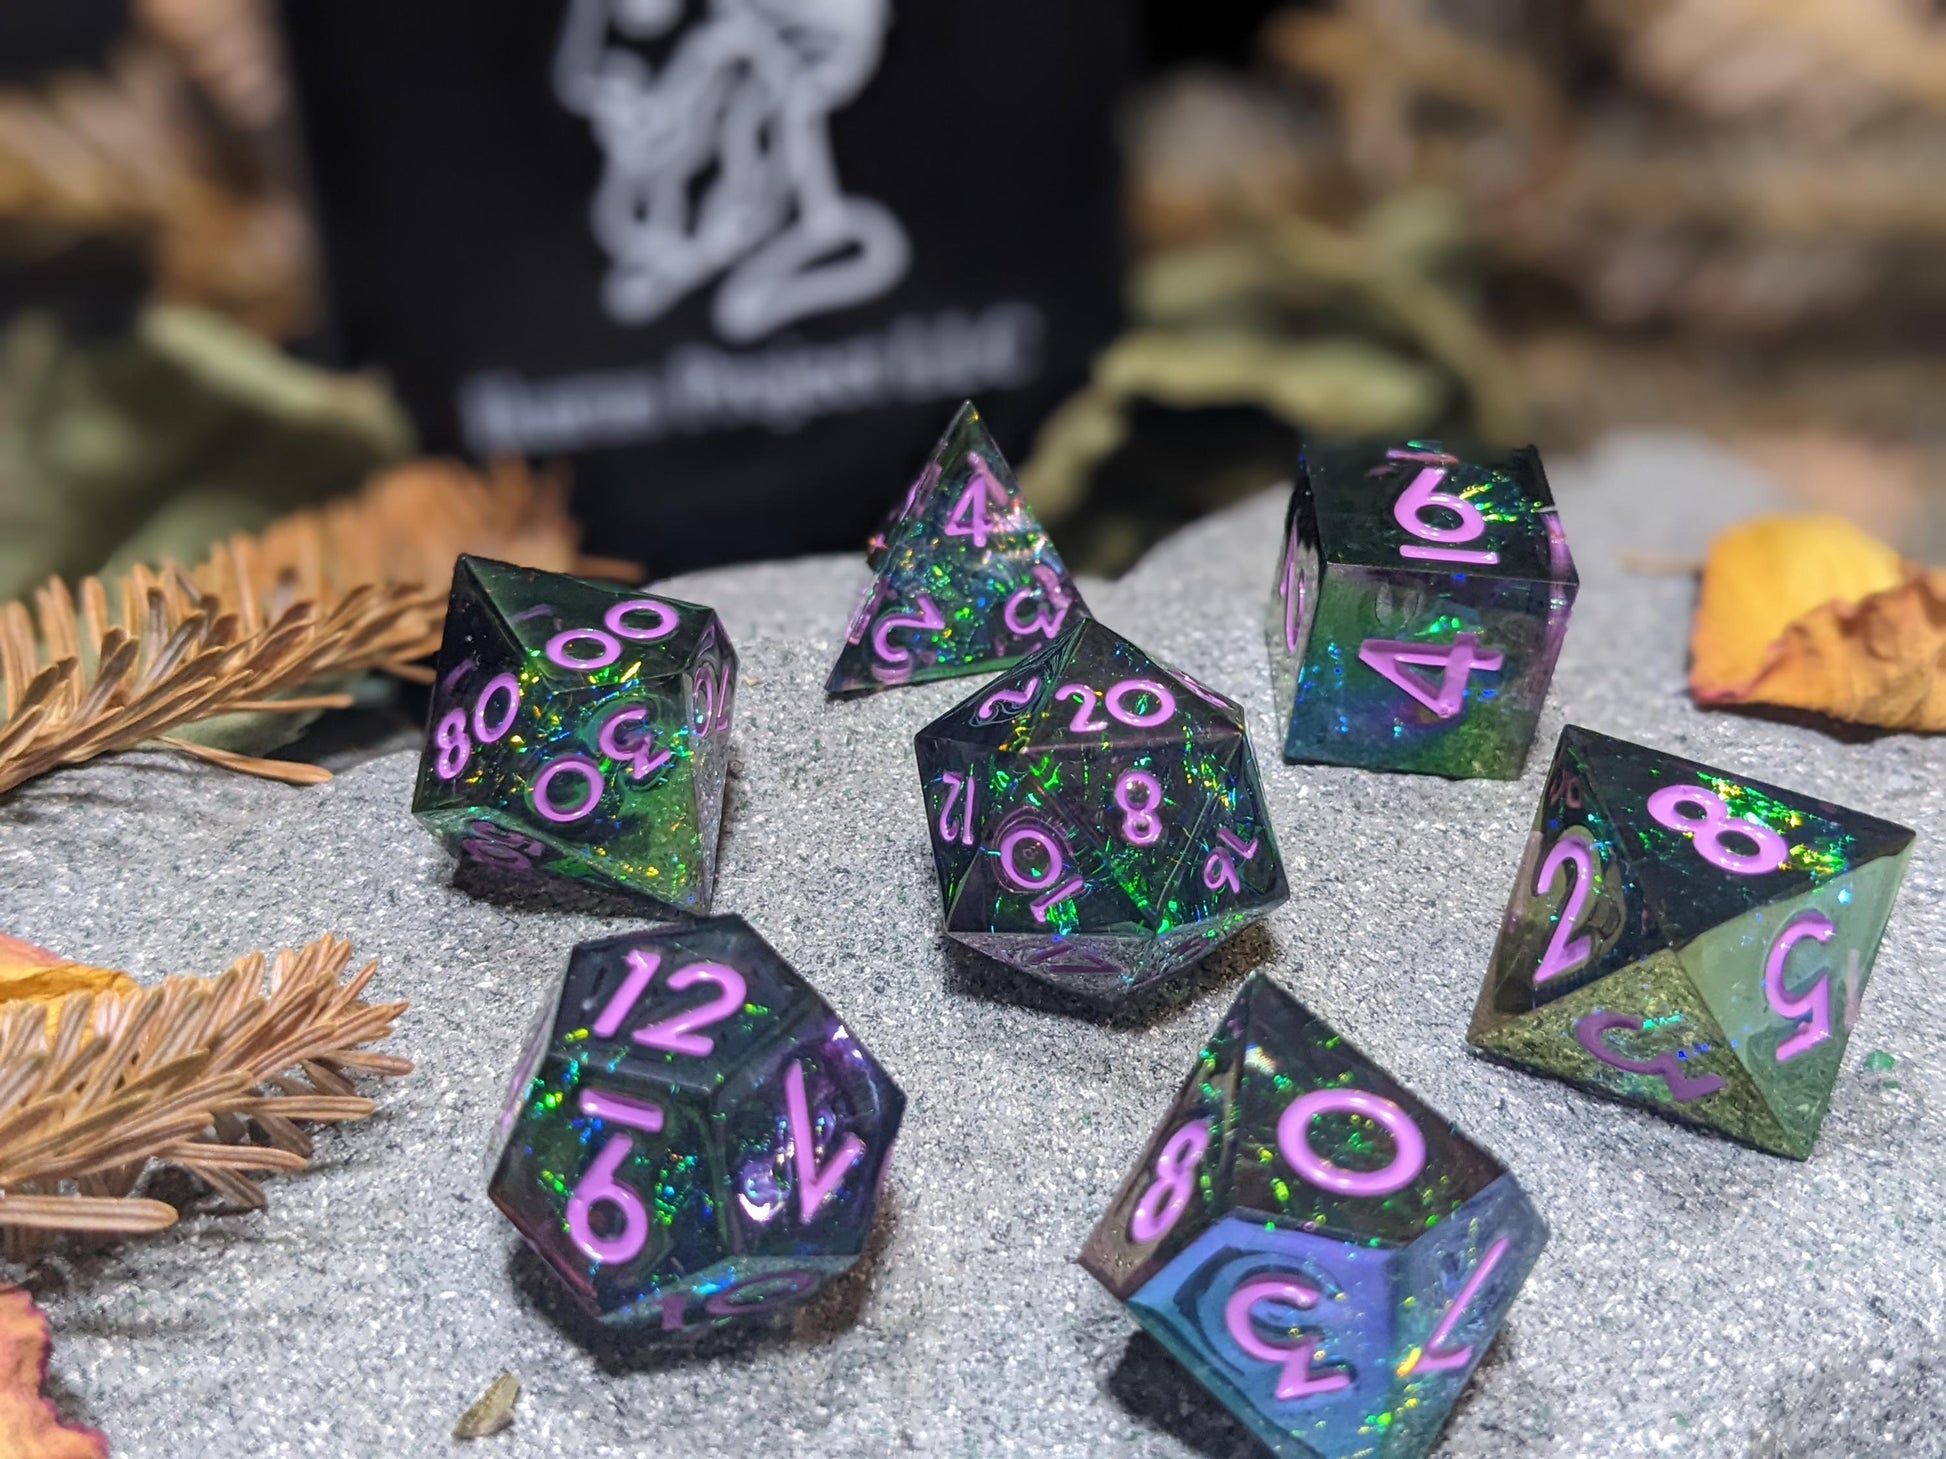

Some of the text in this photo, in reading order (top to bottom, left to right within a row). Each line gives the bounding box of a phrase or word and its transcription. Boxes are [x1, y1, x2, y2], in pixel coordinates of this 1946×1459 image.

[944, 471, 994, 547] 4
[545, 599, 680, 670] 00
[873, 592, 945, 661] 2
[1004, 588, 1067, 639] 3
[1055, 679, 1176, 733] 20
[1358, 632, 1504, 718] 4
[437, 672, 521, 780] 80
[1115, 769, 1163, 846] 8
[1647, 784, 1789, 875] 8
[1533, 835, 1593, 984] 2
[593, 949, 748, 1057] 12
[1764, 909, 1834, 1063] 5
[1575, 1009, 1727, 1101] 3
[1131, 1119, 1210, 1244] 8
[1276, 1088, 1427, 1197] 0
[1225, 1273, 1354, 1402] 3
